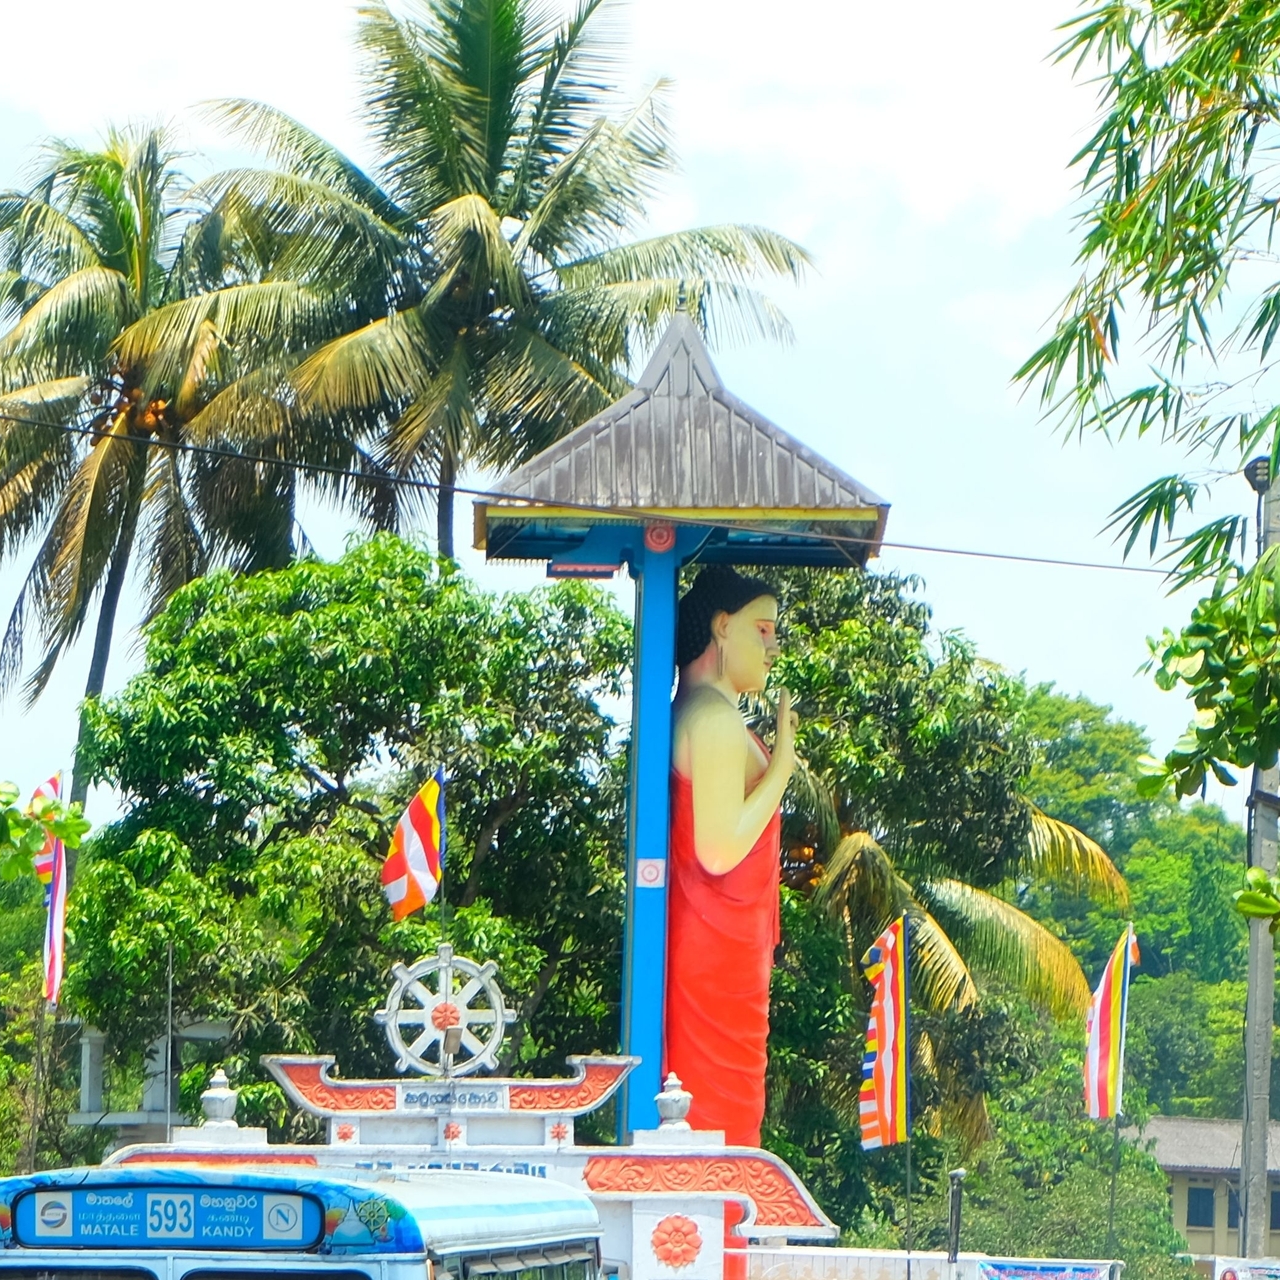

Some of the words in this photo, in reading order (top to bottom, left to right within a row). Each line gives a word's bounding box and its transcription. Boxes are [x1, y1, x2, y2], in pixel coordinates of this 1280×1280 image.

[199, 1194, 258, 1212] මහනුවර
[149, 1199, 193, 1233] 593
[275, 1208, 291, 1227] N
[80, 1224, 140, 1236] MATALE
[202, 1226, 255, 1238] KANDY
